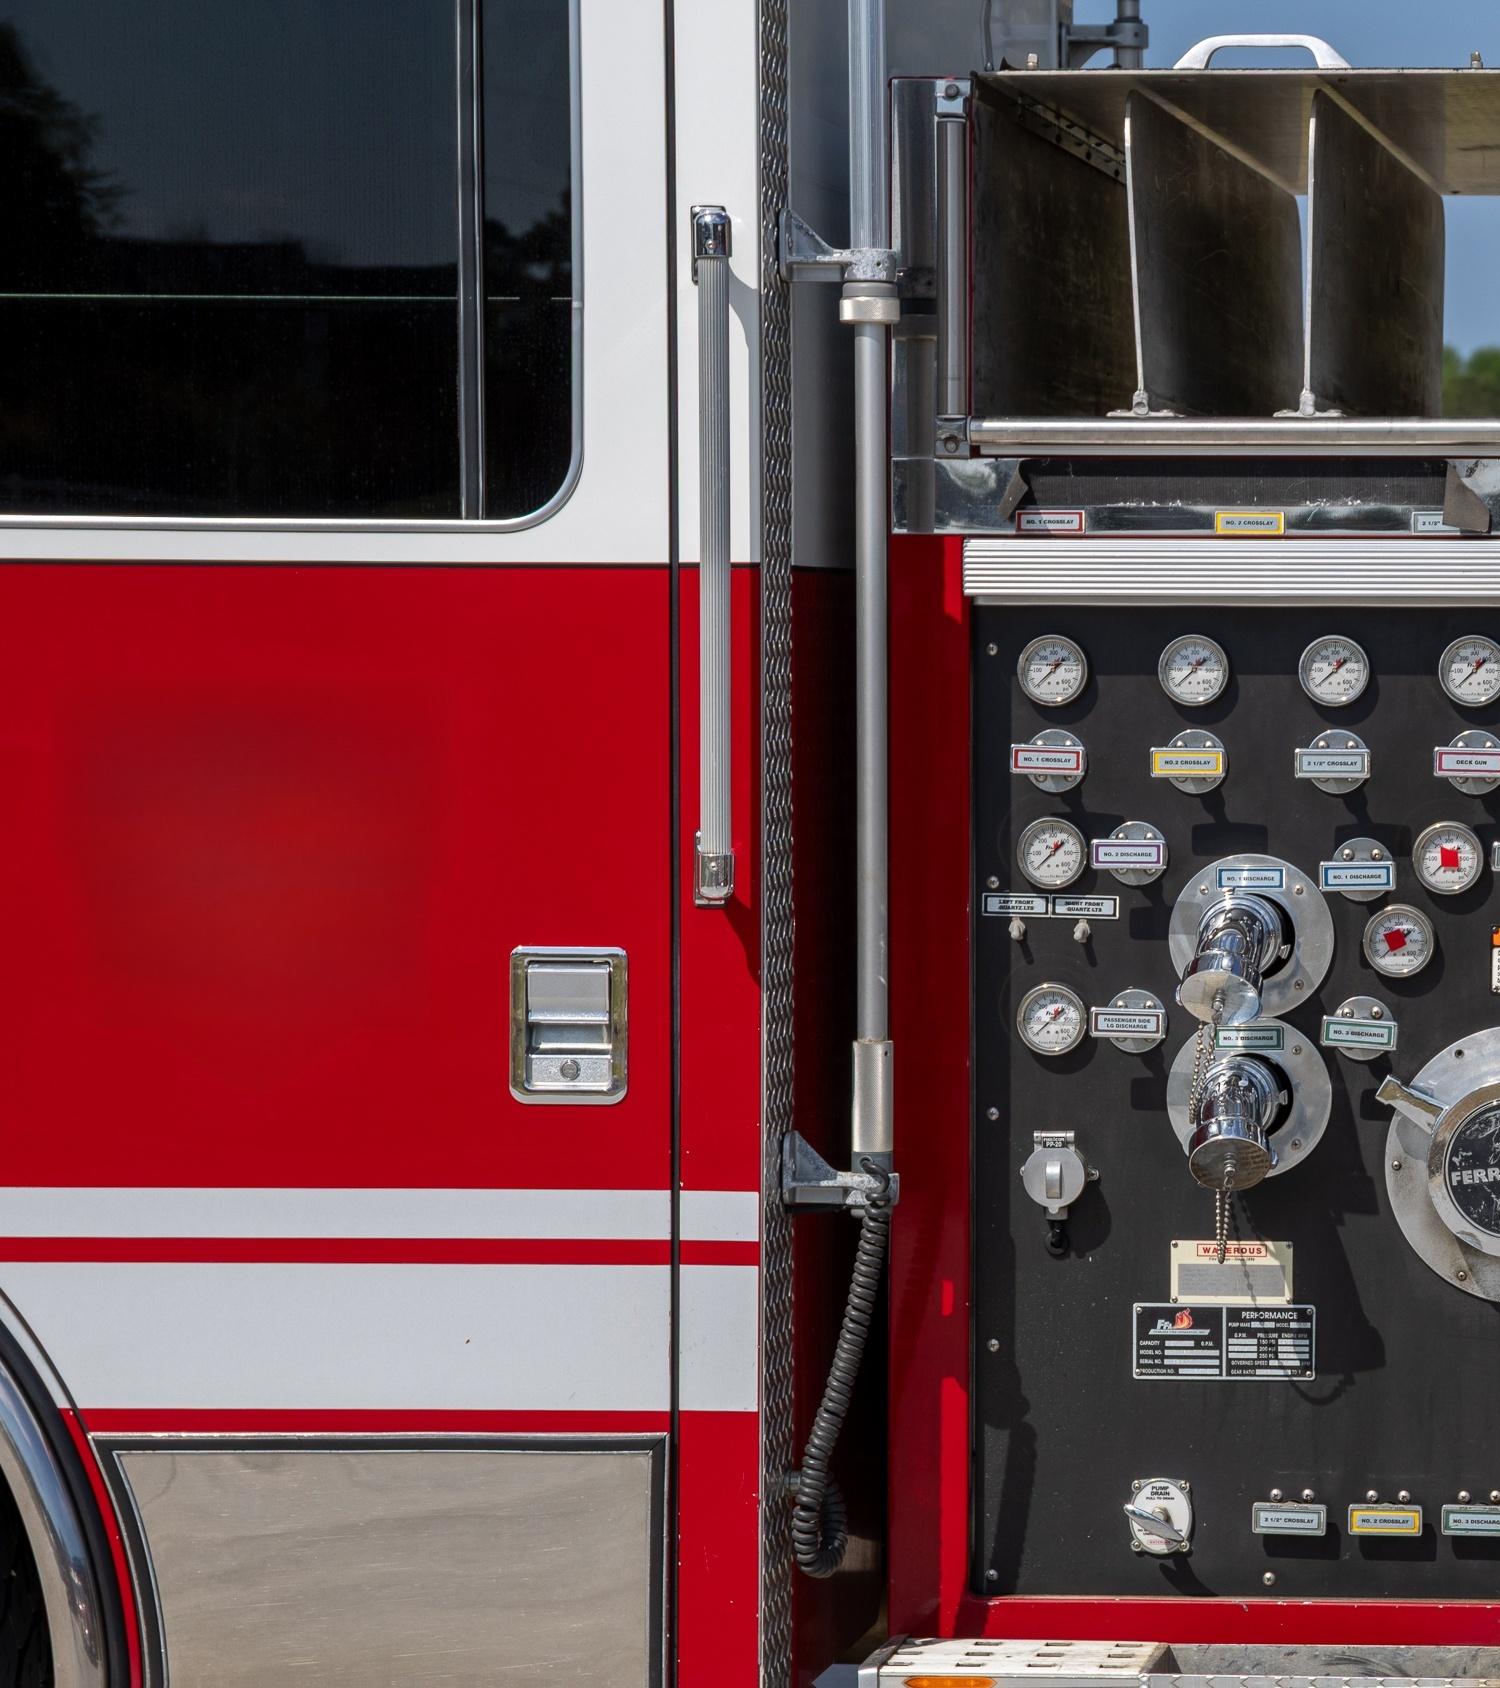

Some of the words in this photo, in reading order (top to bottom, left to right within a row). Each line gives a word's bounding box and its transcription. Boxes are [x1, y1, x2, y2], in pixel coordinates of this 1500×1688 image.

[1350, 1031, 1385, 1039] DISCHARGE
[1202, 1246, 1262, 1254] WAEROUS
[1241, 1311, 1298, 1320] PERFORMANCE
